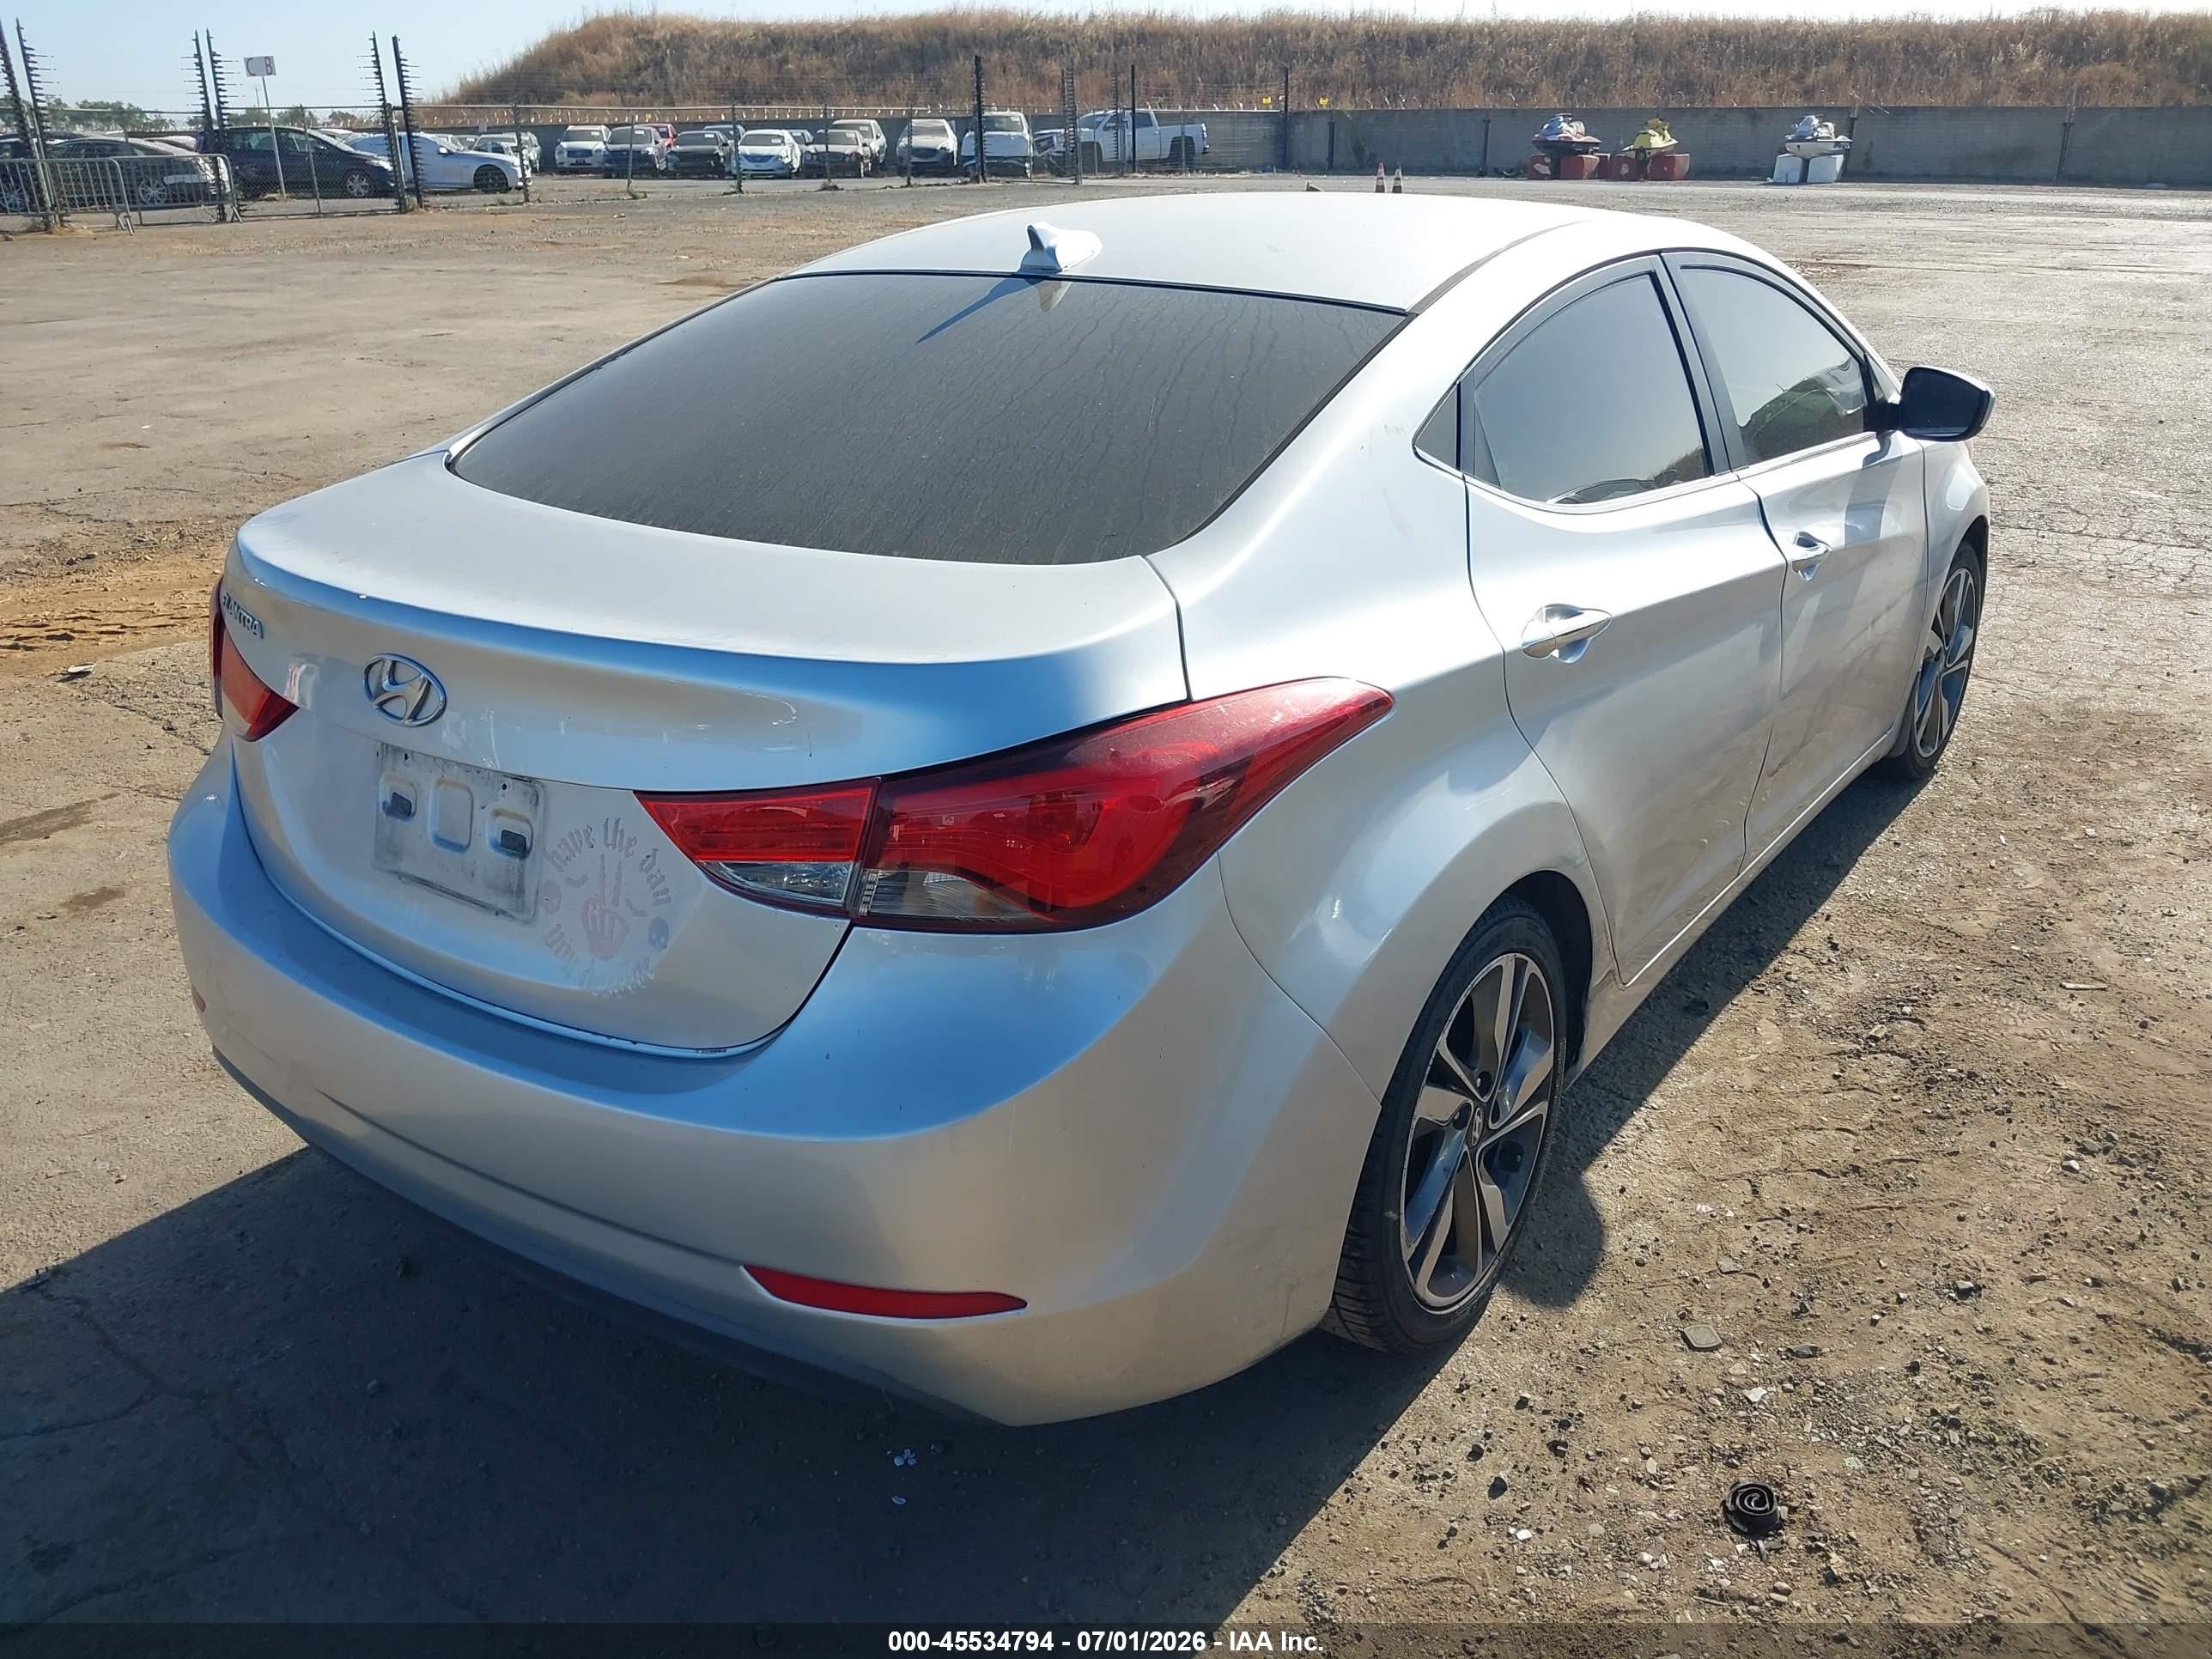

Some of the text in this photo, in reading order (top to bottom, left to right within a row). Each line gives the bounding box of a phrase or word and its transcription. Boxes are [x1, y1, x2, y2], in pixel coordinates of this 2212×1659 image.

[246, 57, 272, 76] C B
[543, 823, 596, 873] have
[603, 817, 638, 858] the
